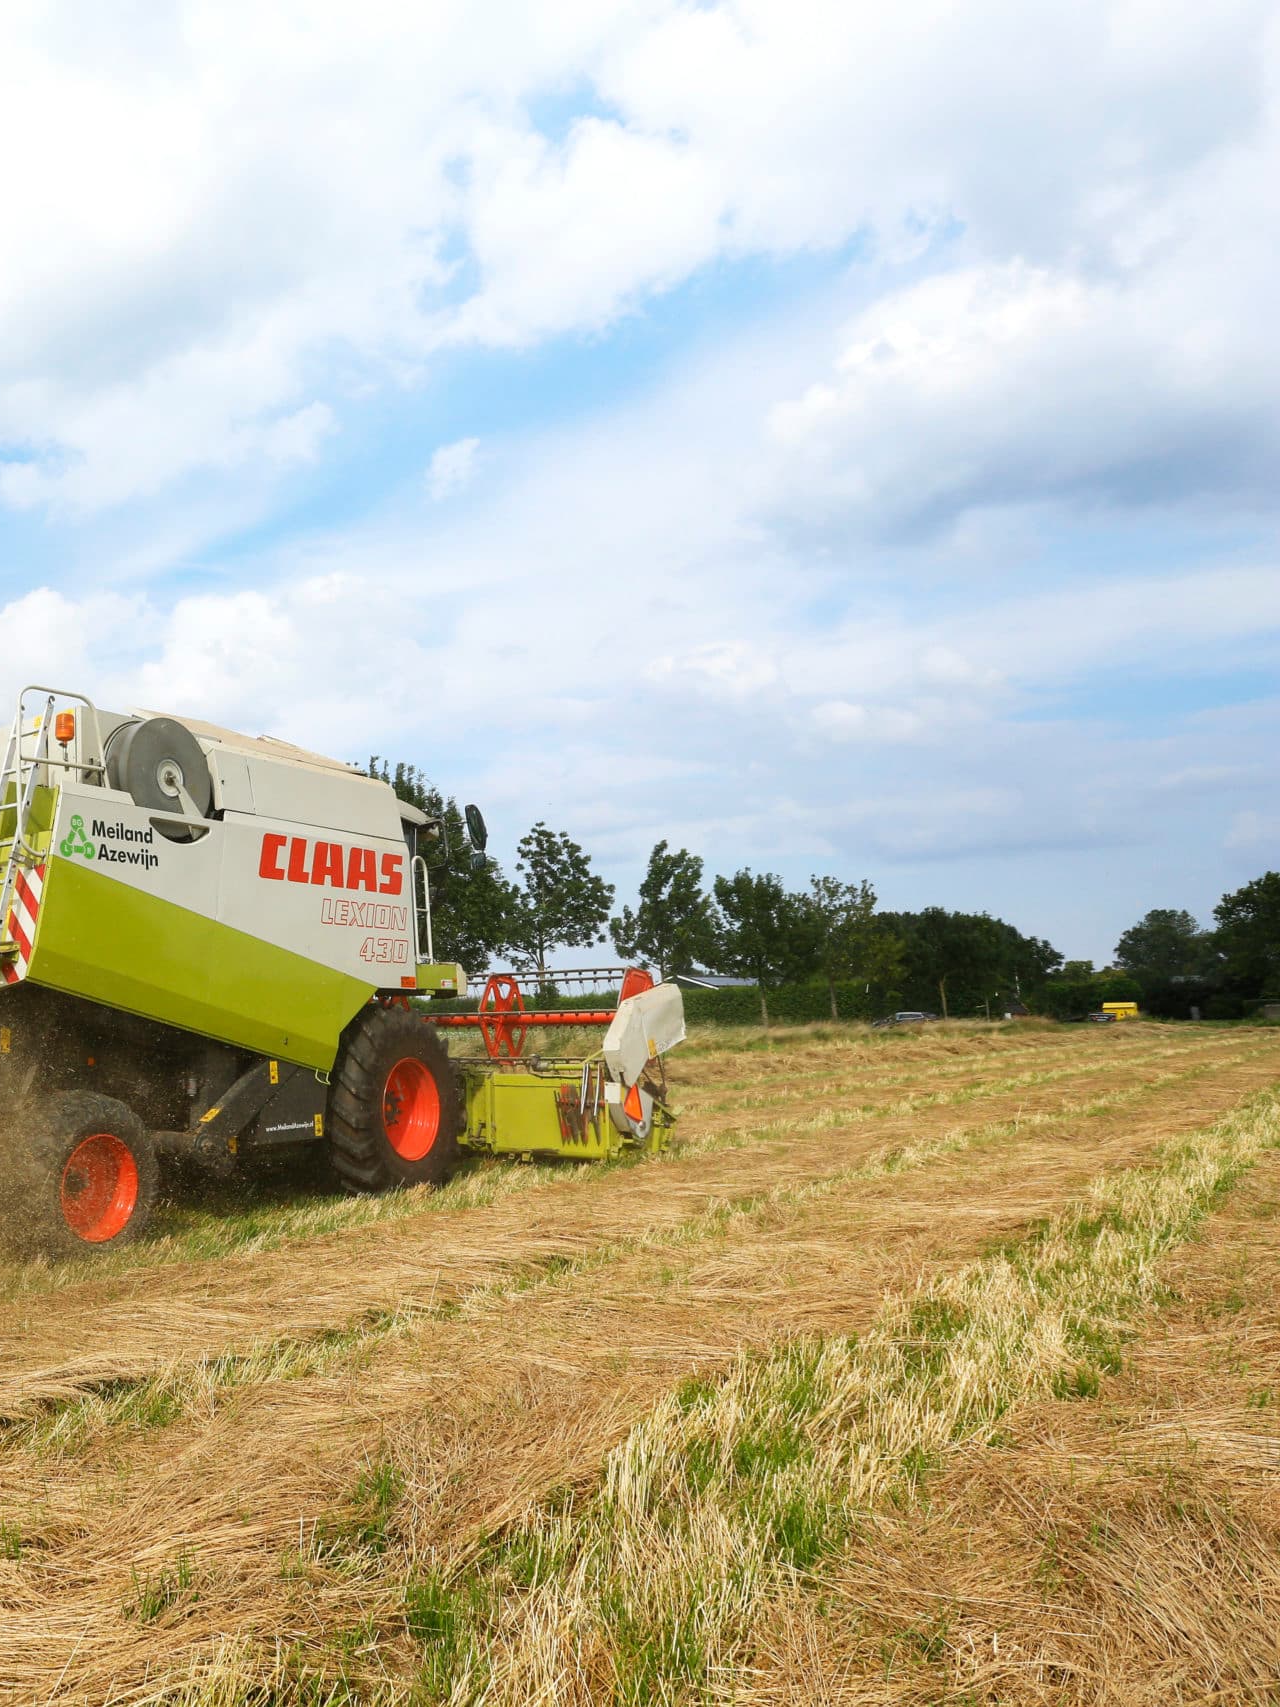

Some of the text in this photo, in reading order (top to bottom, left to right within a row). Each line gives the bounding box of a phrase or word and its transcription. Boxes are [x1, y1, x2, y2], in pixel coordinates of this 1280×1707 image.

[92, 819, 153, 844] Meiland
[98, 844, 159, 870] Azewijn
[258, 833, 403, 895] CLAAS
[321, 898, 408, 931] LEXION
[360, 937, 409, 964] 430
